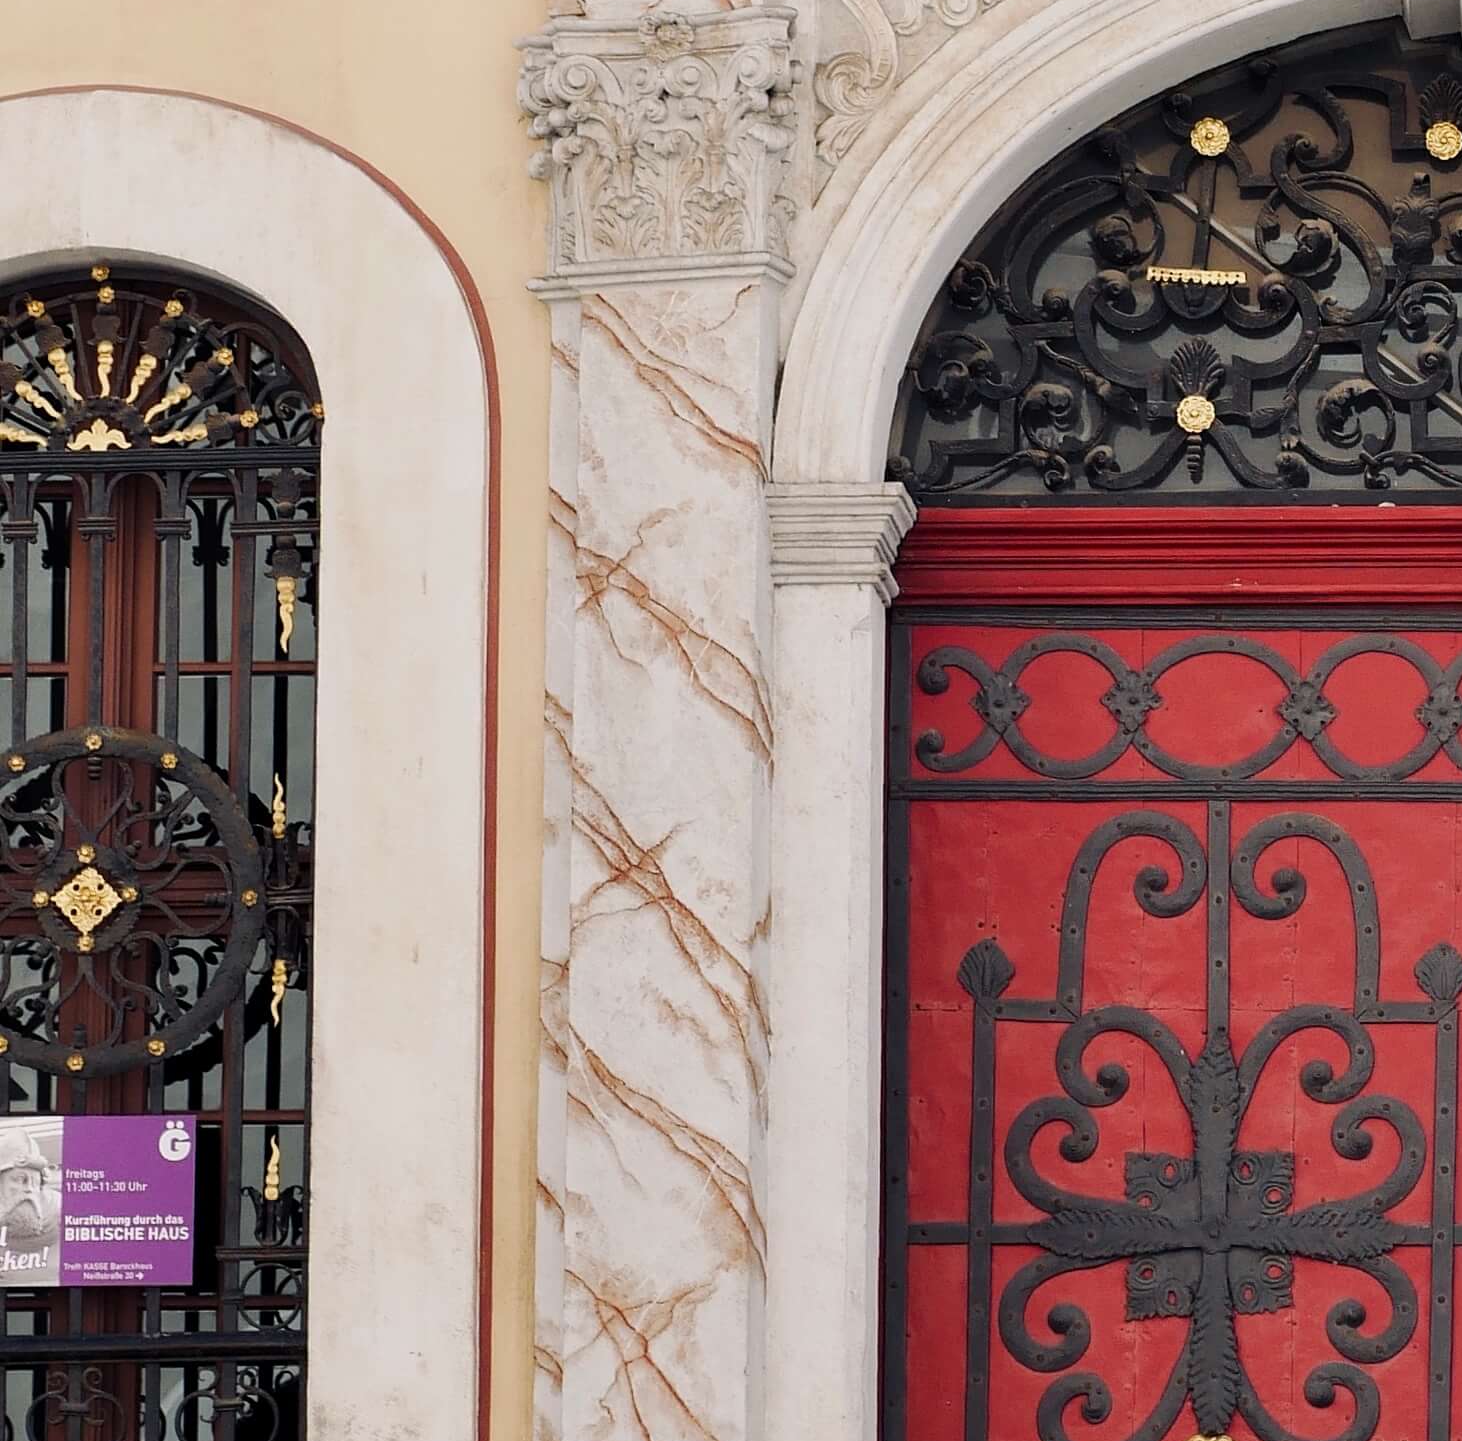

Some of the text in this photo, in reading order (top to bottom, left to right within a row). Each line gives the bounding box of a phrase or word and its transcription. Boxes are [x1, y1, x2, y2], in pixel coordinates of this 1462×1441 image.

[65, 1168, 105, 1181] freitags
[128, 1181, 148, 1192] Uhr
[64, 1214, 184, 1227] Kurzführung durch das
[64, 1227, 190, 1242] BIBLISCHE HAUS
